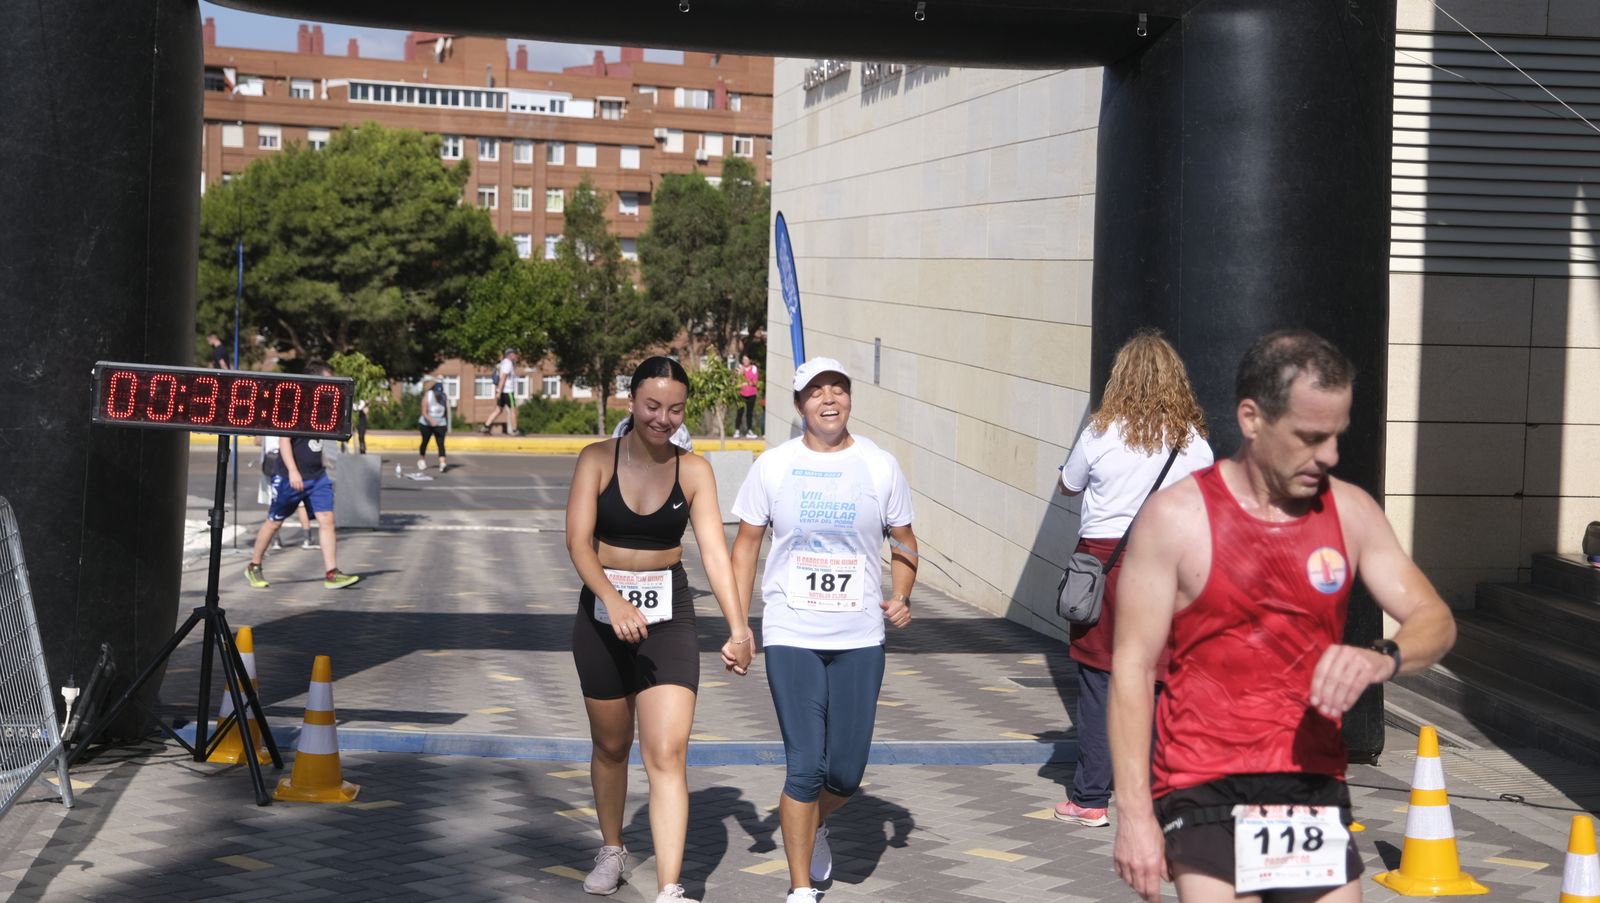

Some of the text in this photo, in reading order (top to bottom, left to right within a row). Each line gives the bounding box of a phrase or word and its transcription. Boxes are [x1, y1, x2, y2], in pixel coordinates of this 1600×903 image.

[107, 371, 340, 432] 00:38:00
[801, 490, 823, 500] VIII
[800, 500, 856, 511] CARRERA
[800, 509, 857, 521] POPULAR
[806, 572, 852, 592] 187
[1253, 826, 1324, 855] 118
